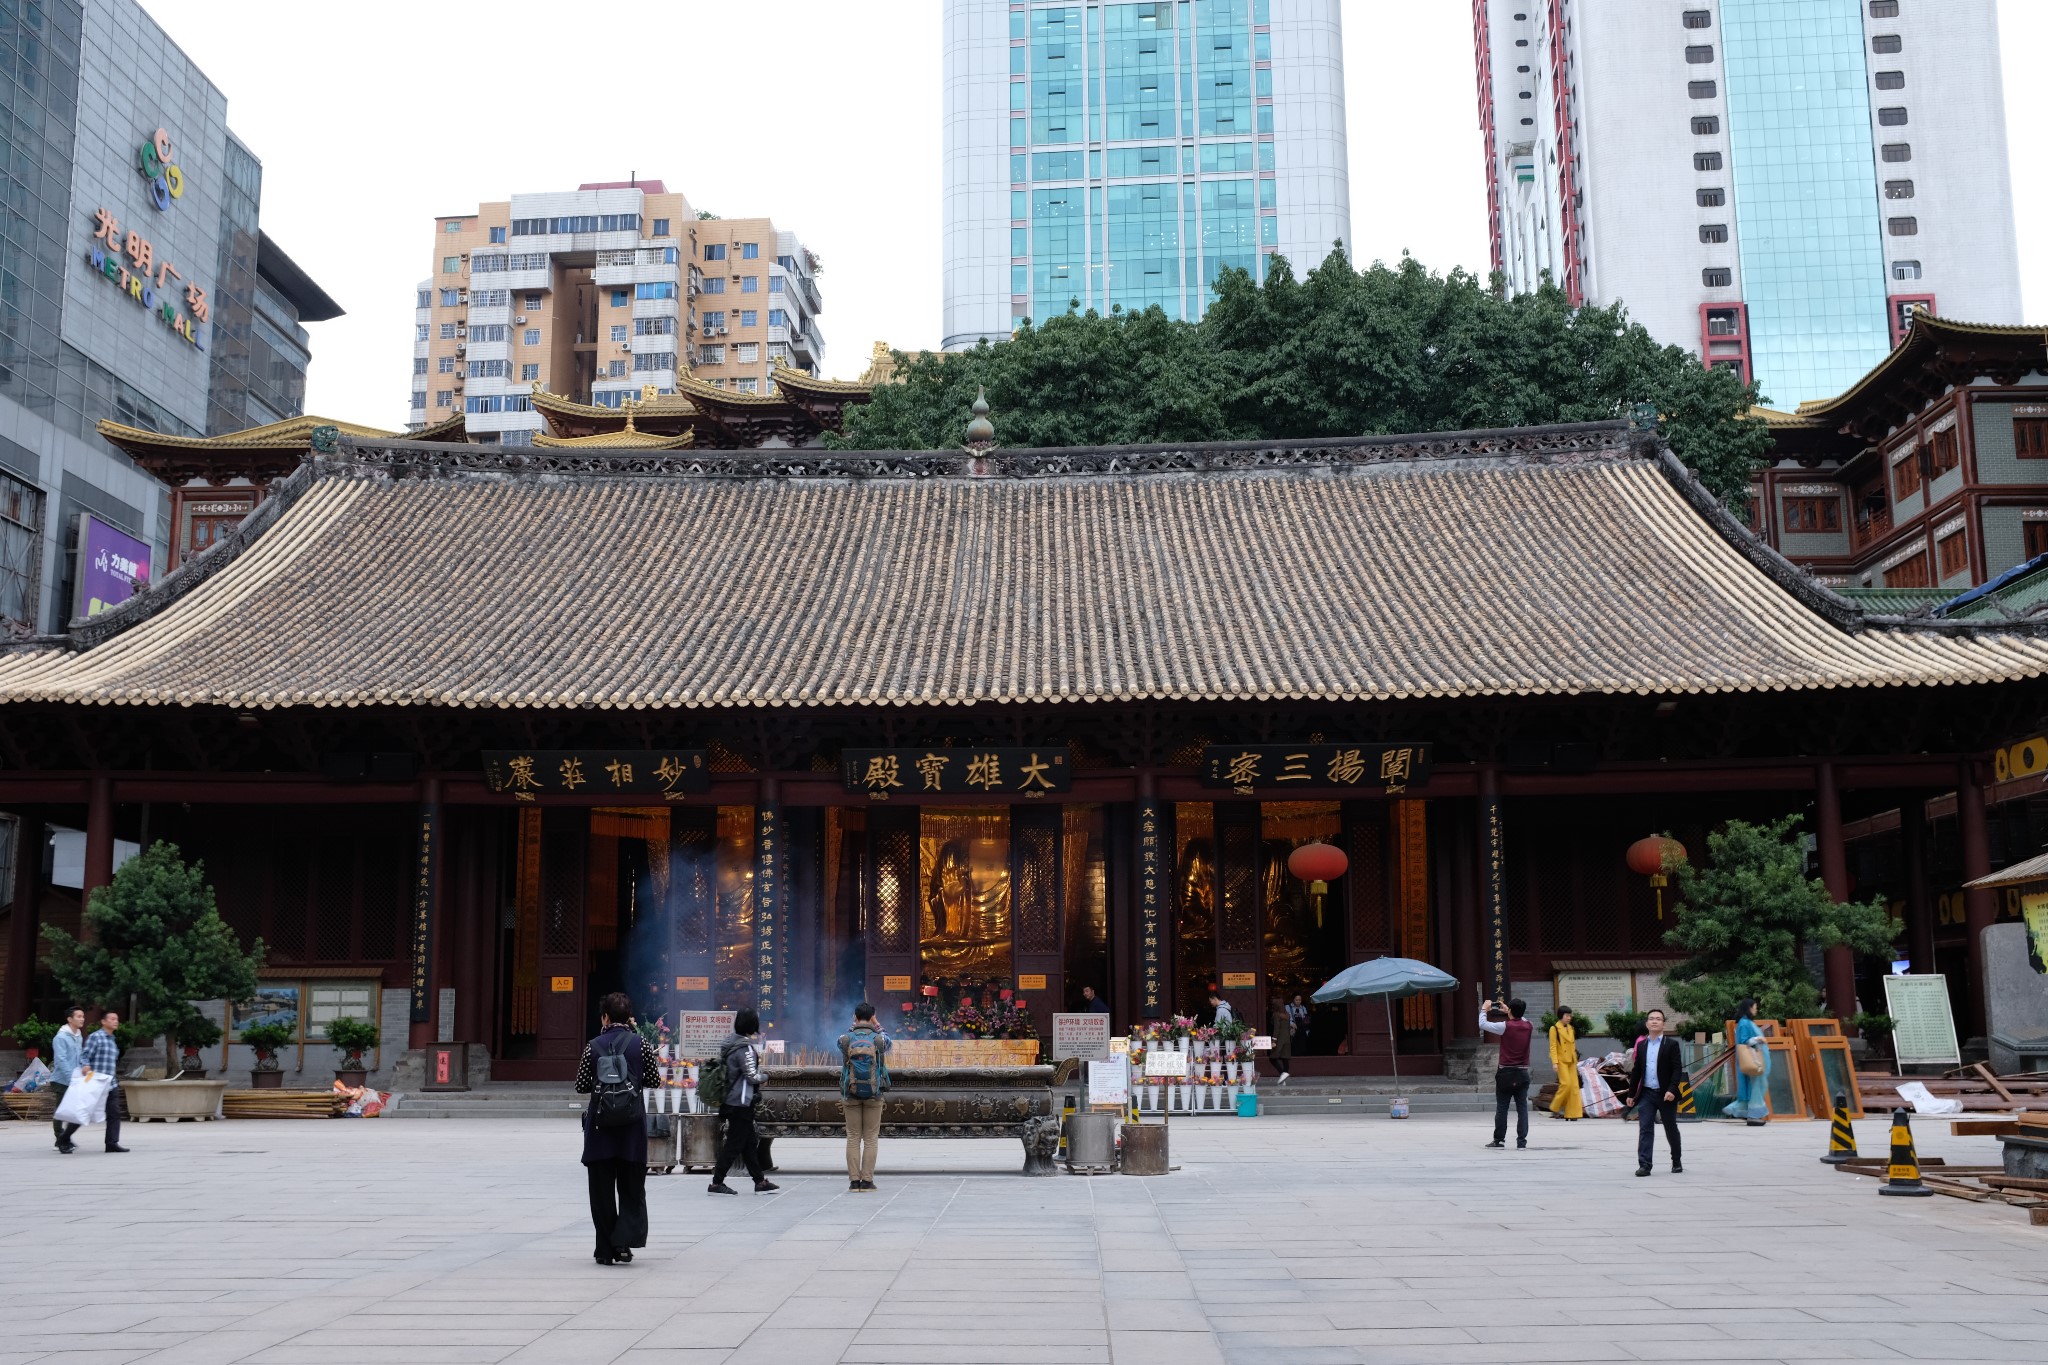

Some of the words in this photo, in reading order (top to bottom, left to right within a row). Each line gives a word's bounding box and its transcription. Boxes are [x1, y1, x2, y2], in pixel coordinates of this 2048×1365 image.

[92, 246, 153, 309] METRO
[163, 302, 205, 351] MALL
[94, 207, 208, 323] 光明广场
[111, 553, 137, 578] 力美健
[862, 752, 1056, 791] 大雄寶殿
